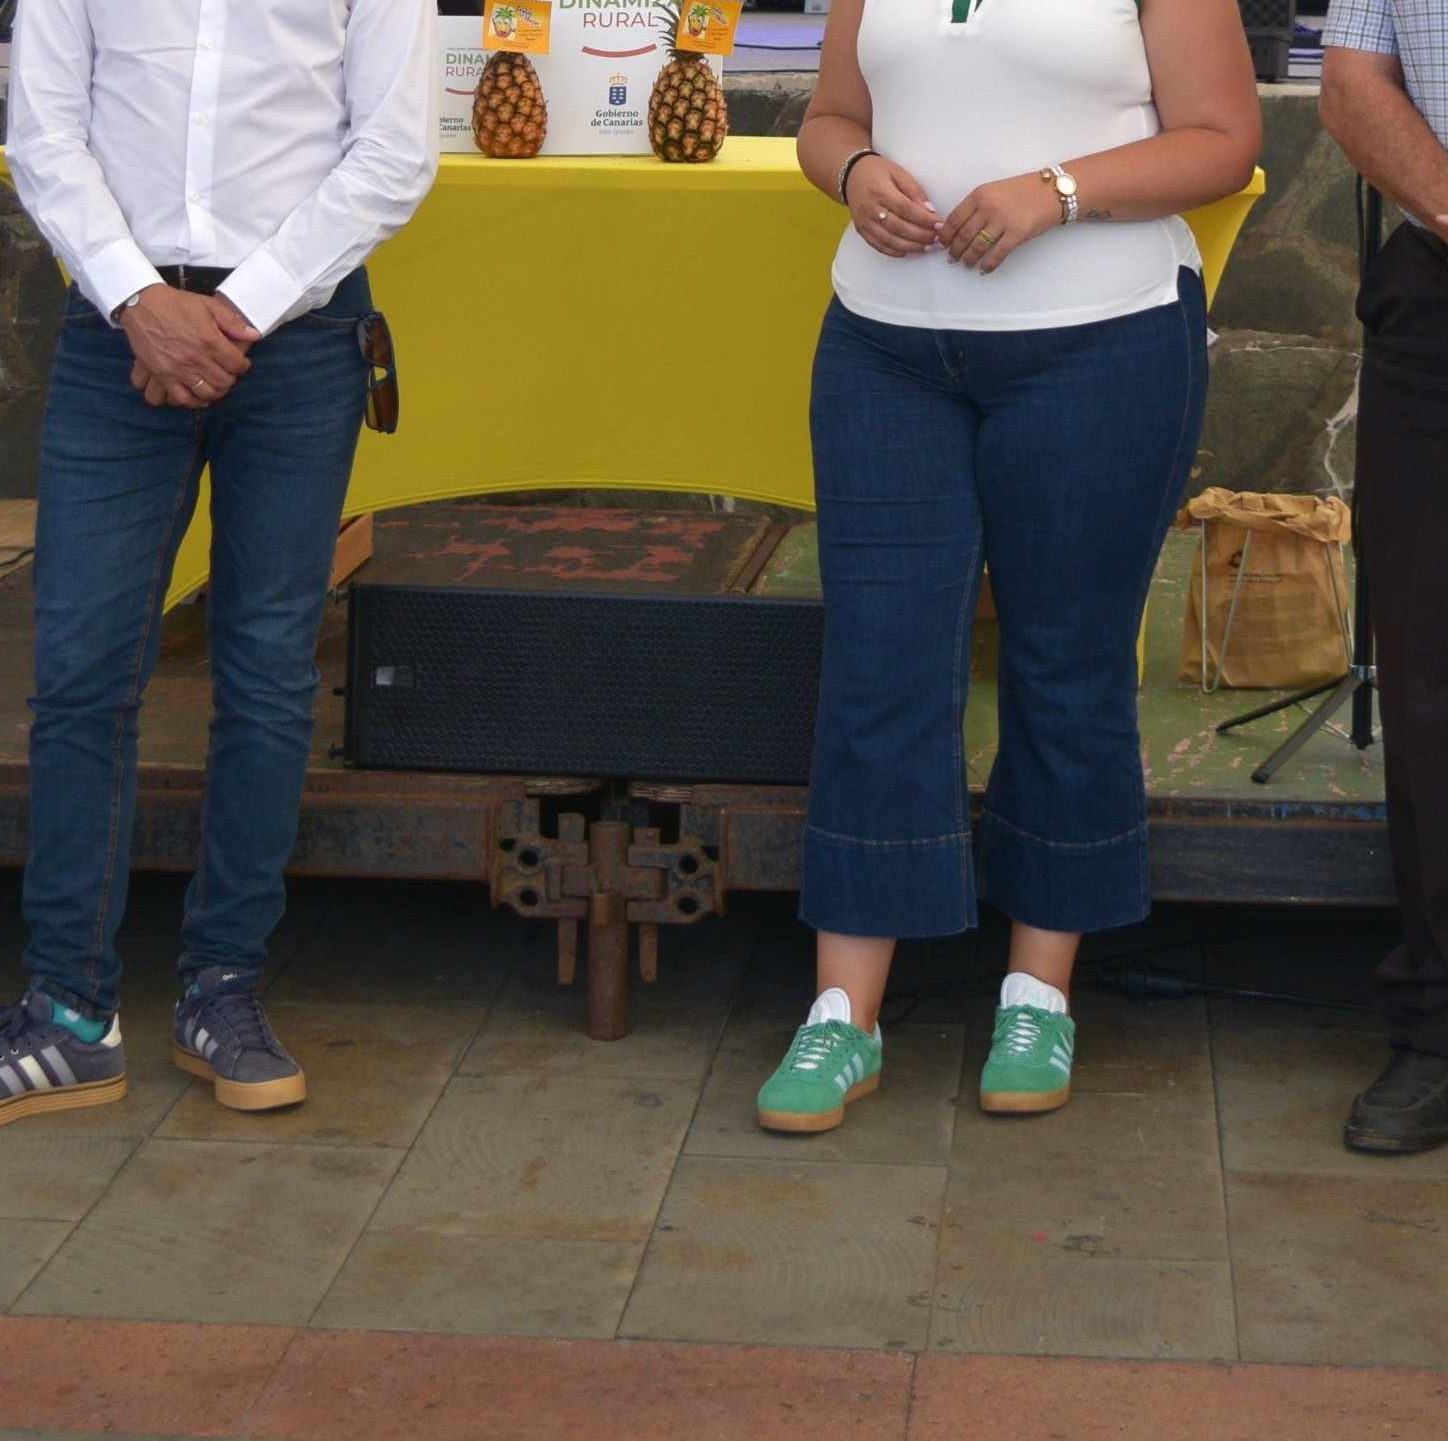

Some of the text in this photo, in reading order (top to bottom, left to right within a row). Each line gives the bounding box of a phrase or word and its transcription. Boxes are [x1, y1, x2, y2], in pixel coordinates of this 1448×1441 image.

[583, 11, 659, 28] RURAL
[595, 108, 640, 118] Gobierno
[590, 118, 644, 127] de Canarias
